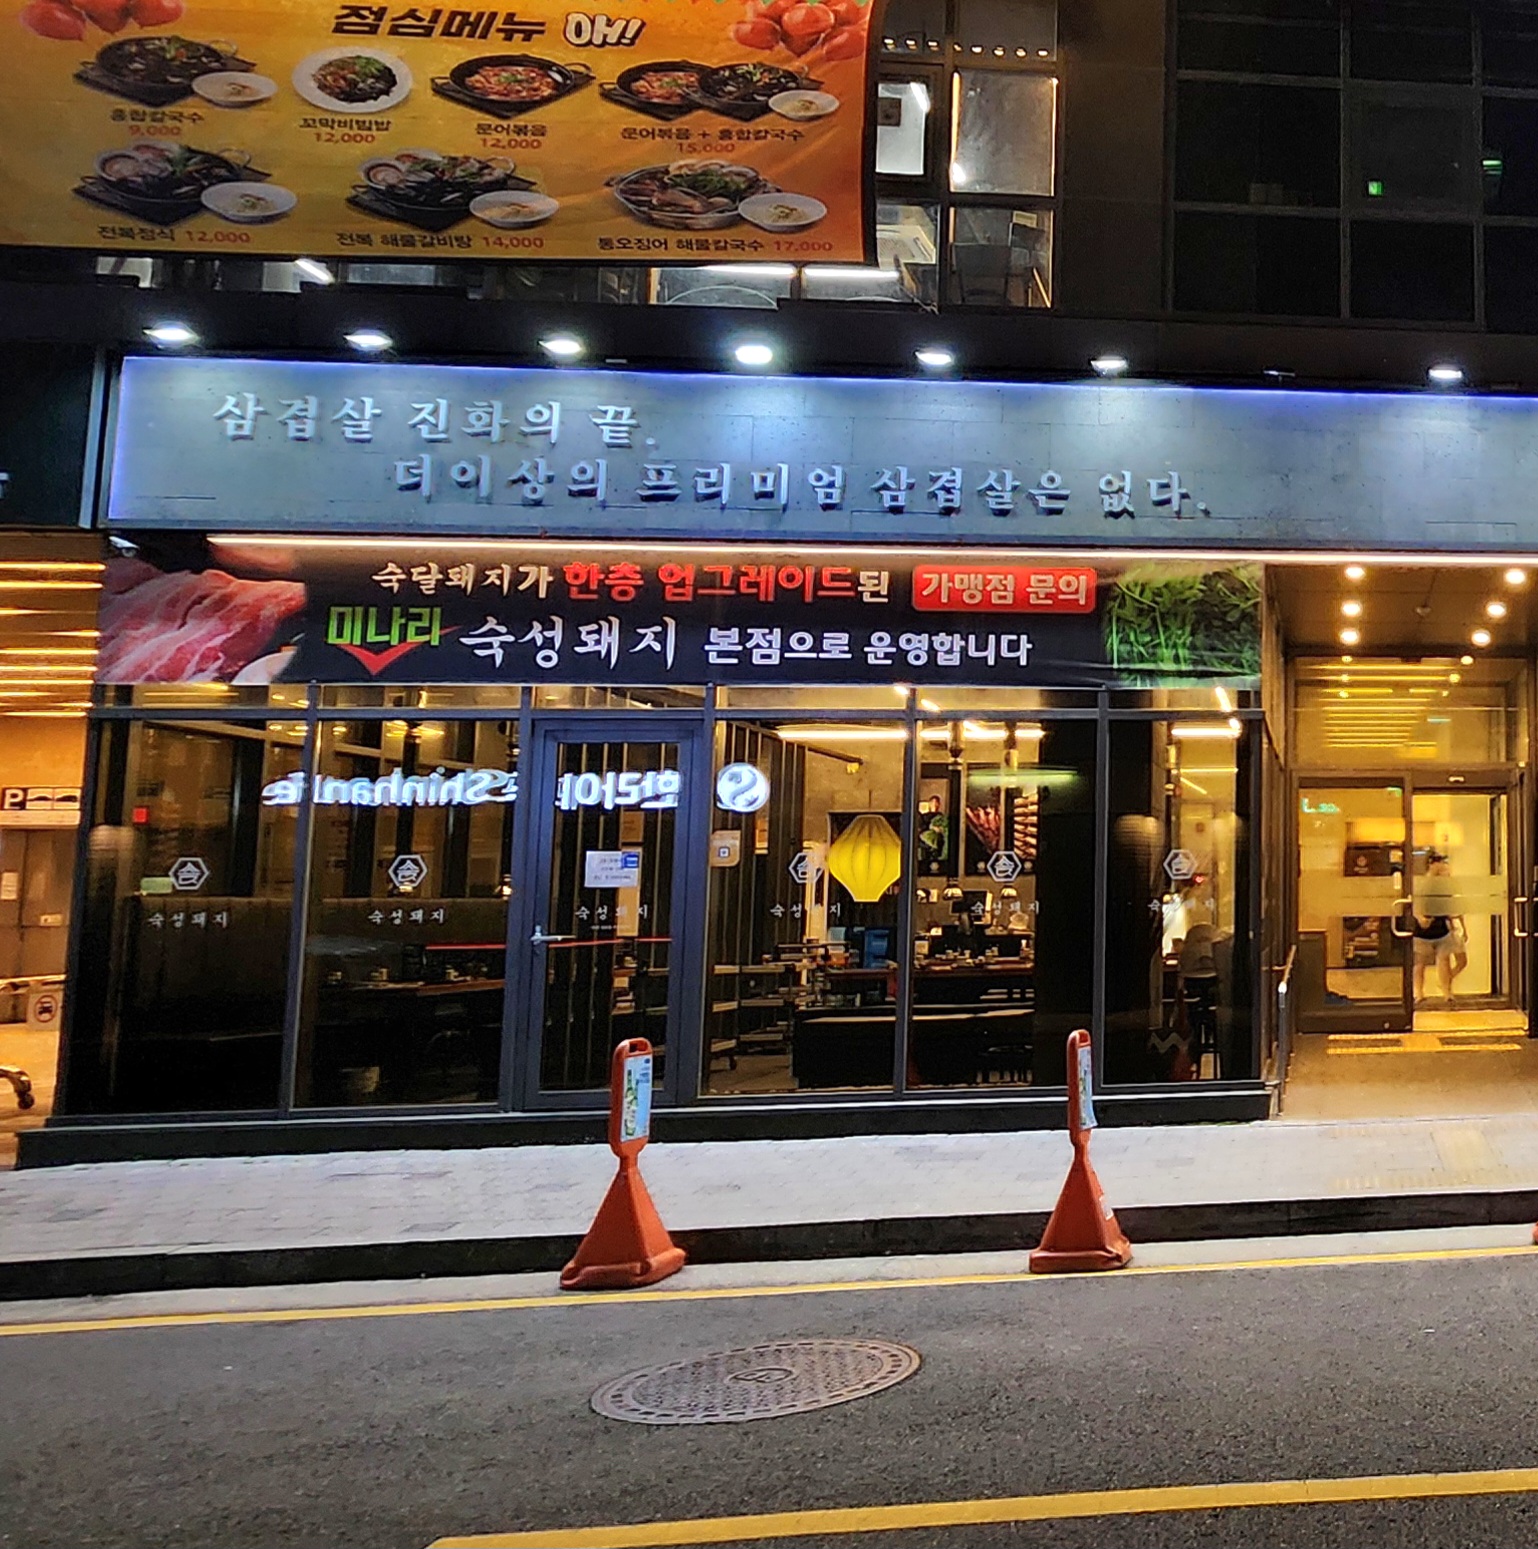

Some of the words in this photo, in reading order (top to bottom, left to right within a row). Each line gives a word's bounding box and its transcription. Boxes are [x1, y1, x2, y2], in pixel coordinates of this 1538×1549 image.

[331, 4, 547, 42] 점심메뉴
[128, 125, 182, 137] 9,000
[312, 131, 376, 144] 12,000
[475, 122, 548, 137] 문어볶음
[621, 126, 693, 141] 문어볶음
[480, 137, 542, 150] 12,000
[676, 142, 736, 154] 15,000
[97, 225, 176, 242] 전복정식
[185, 230, 251, 243] 12,000
[336, 232, 373, 247] 전복
[482, 235, 544, 249] 14,000
[773, 240, 833, 253] 17,000
[212, 392, 384, 443] 삼겹살
[407, 397, 563, 446] 진화의
[590, 402, 657, 448] 끝.
[635, 461, 847, 513] 프리미엄
[871, 465, 1072, 517] 삼겹살은
[1098, 469, 1212, 520] 없다.
[372, 561, 554, 600] 숙달돼지가
[562, 561, 645, 602] 한층
[657, 562, 889, 604] 업그레이드된
[921, 570, 1015, 606] 가맹점
[1025, 572, 1088, 606] 문의
[327, 604, 442, 647] 미나리
[458, 614, 678, 671] 숙성돼지
[704, 625, 853, 667] 본점으로
[863, 628, 1034, 668] 운영합니다
[367, 908, 446, 926] 숙성돼지
